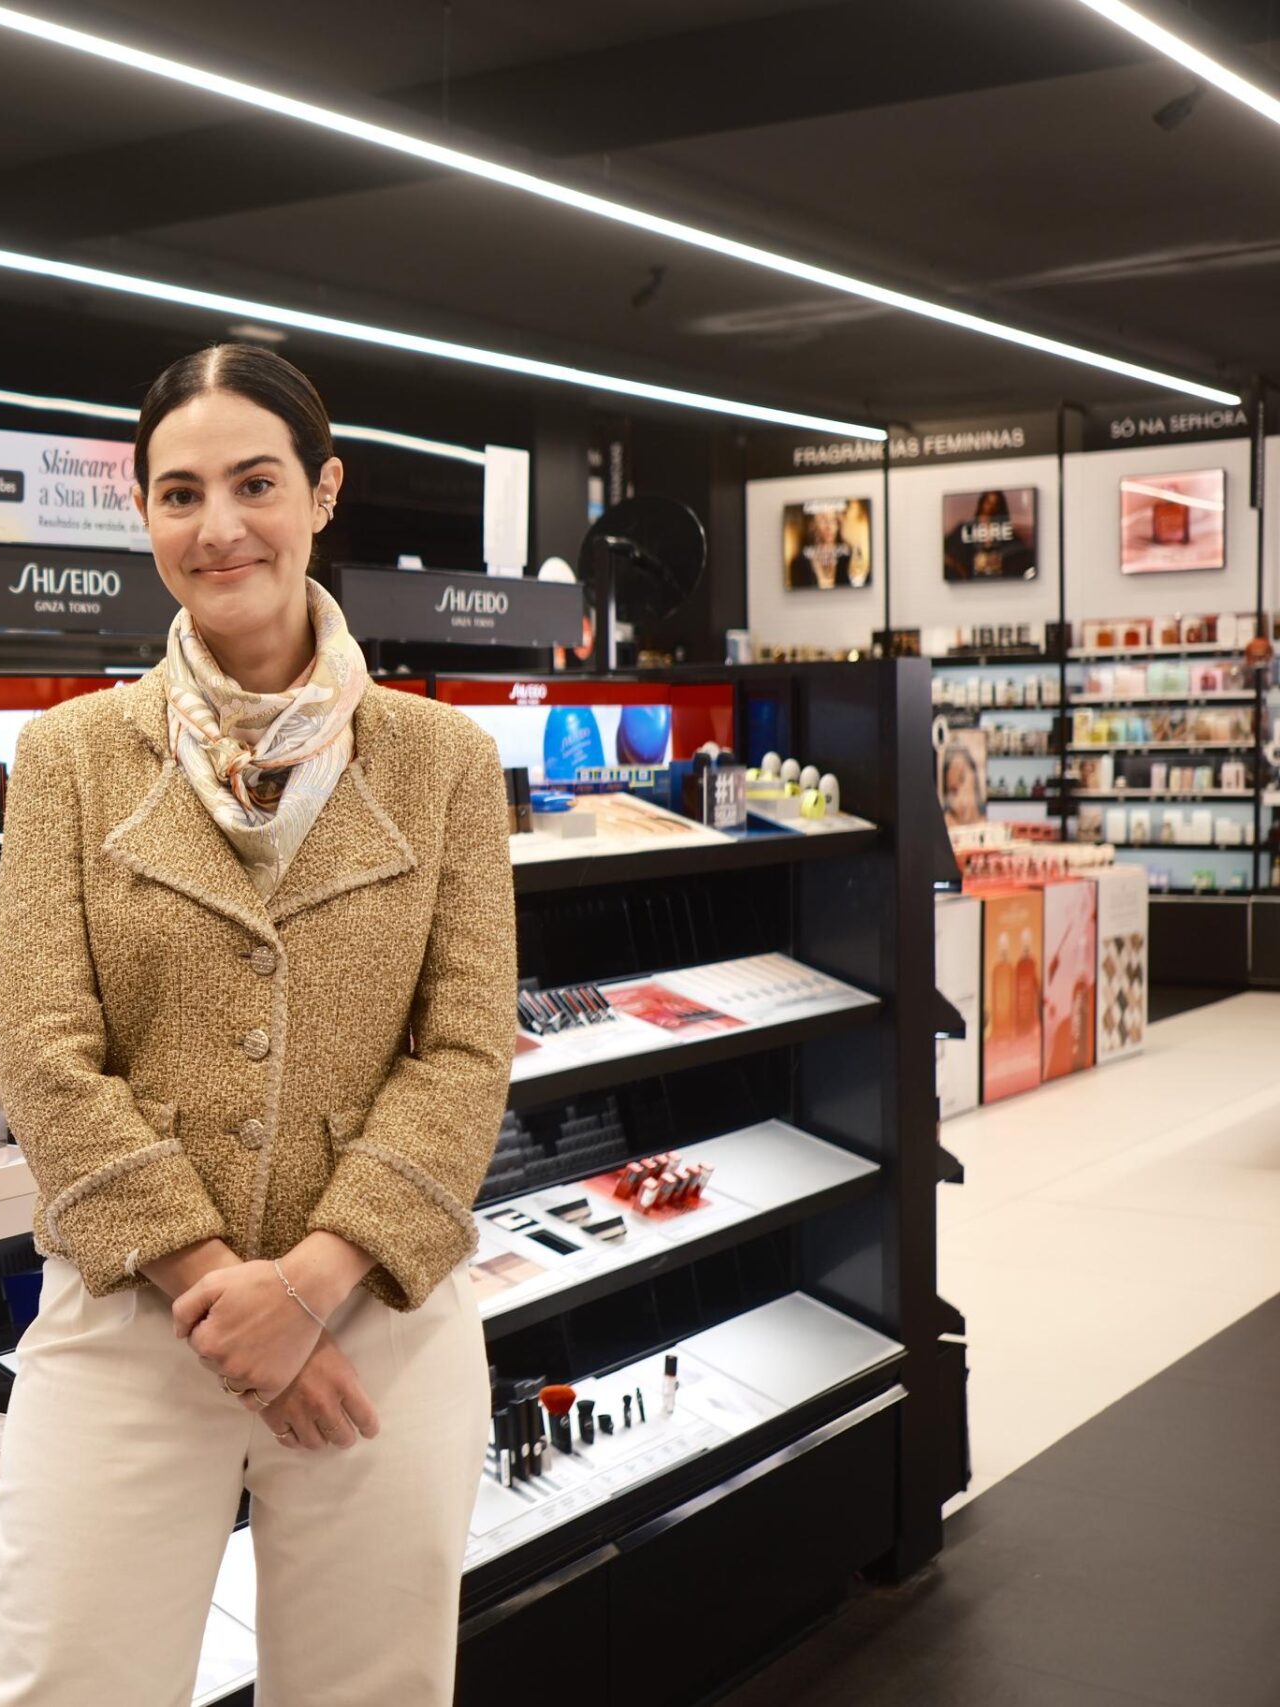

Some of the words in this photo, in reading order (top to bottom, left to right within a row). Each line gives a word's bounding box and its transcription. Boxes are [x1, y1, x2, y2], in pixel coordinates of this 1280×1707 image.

[1110, 416, 1135, 439] SÓ
[1138, 416, 1166, 436] NA
[1169, 409, 1248, 433] SEPHORA
[924, 427, 1025, 456] FEMININAS
[39, 449, 117, 479] Skincare
[39, 488, 48, 506] a
[54, 483, 85, 508] Sua
[961, 522, 1014, 544] LIBRE
[8, 563, 120, 597] SHISEIDO
[35, 601, 64, 613] GINZA
[68, 602, 100, 614] TOKYO
[434, 585, 509, 614] SHISEIDO
